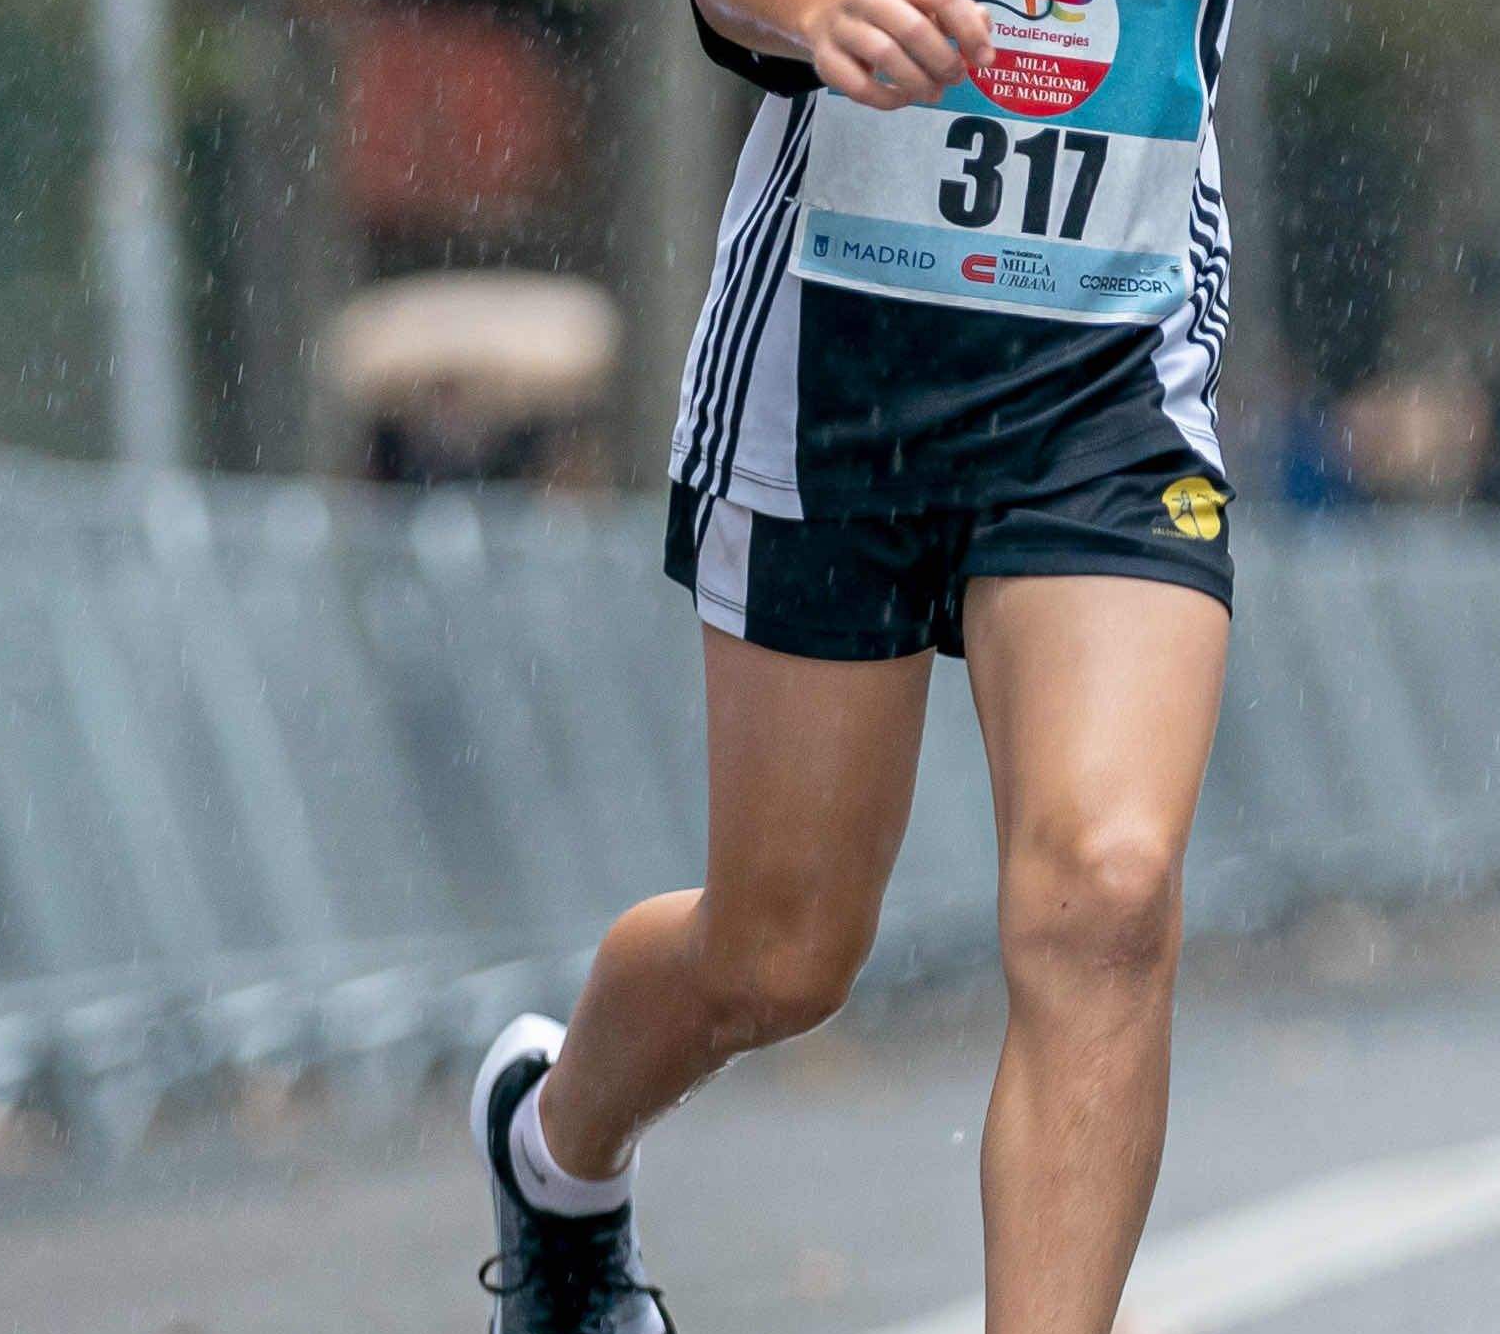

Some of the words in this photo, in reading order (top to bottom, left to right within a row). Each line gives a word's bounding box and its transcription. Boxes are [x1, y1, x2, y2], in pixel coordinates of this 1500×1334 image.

[995, 23, 1090, 48] TotalEnergies
[1014, 55, 1061, 74] MILLA
[992, 83, 1014, 98] DE
[1017, 86, 1073, 105] MADRID
[938, 115, 1110, 241] 317
[842, 240, 937, 269] MADRID
[1000, 257, 1052, 277] MILLA
[999, 272, 1056, 293] URBANA
